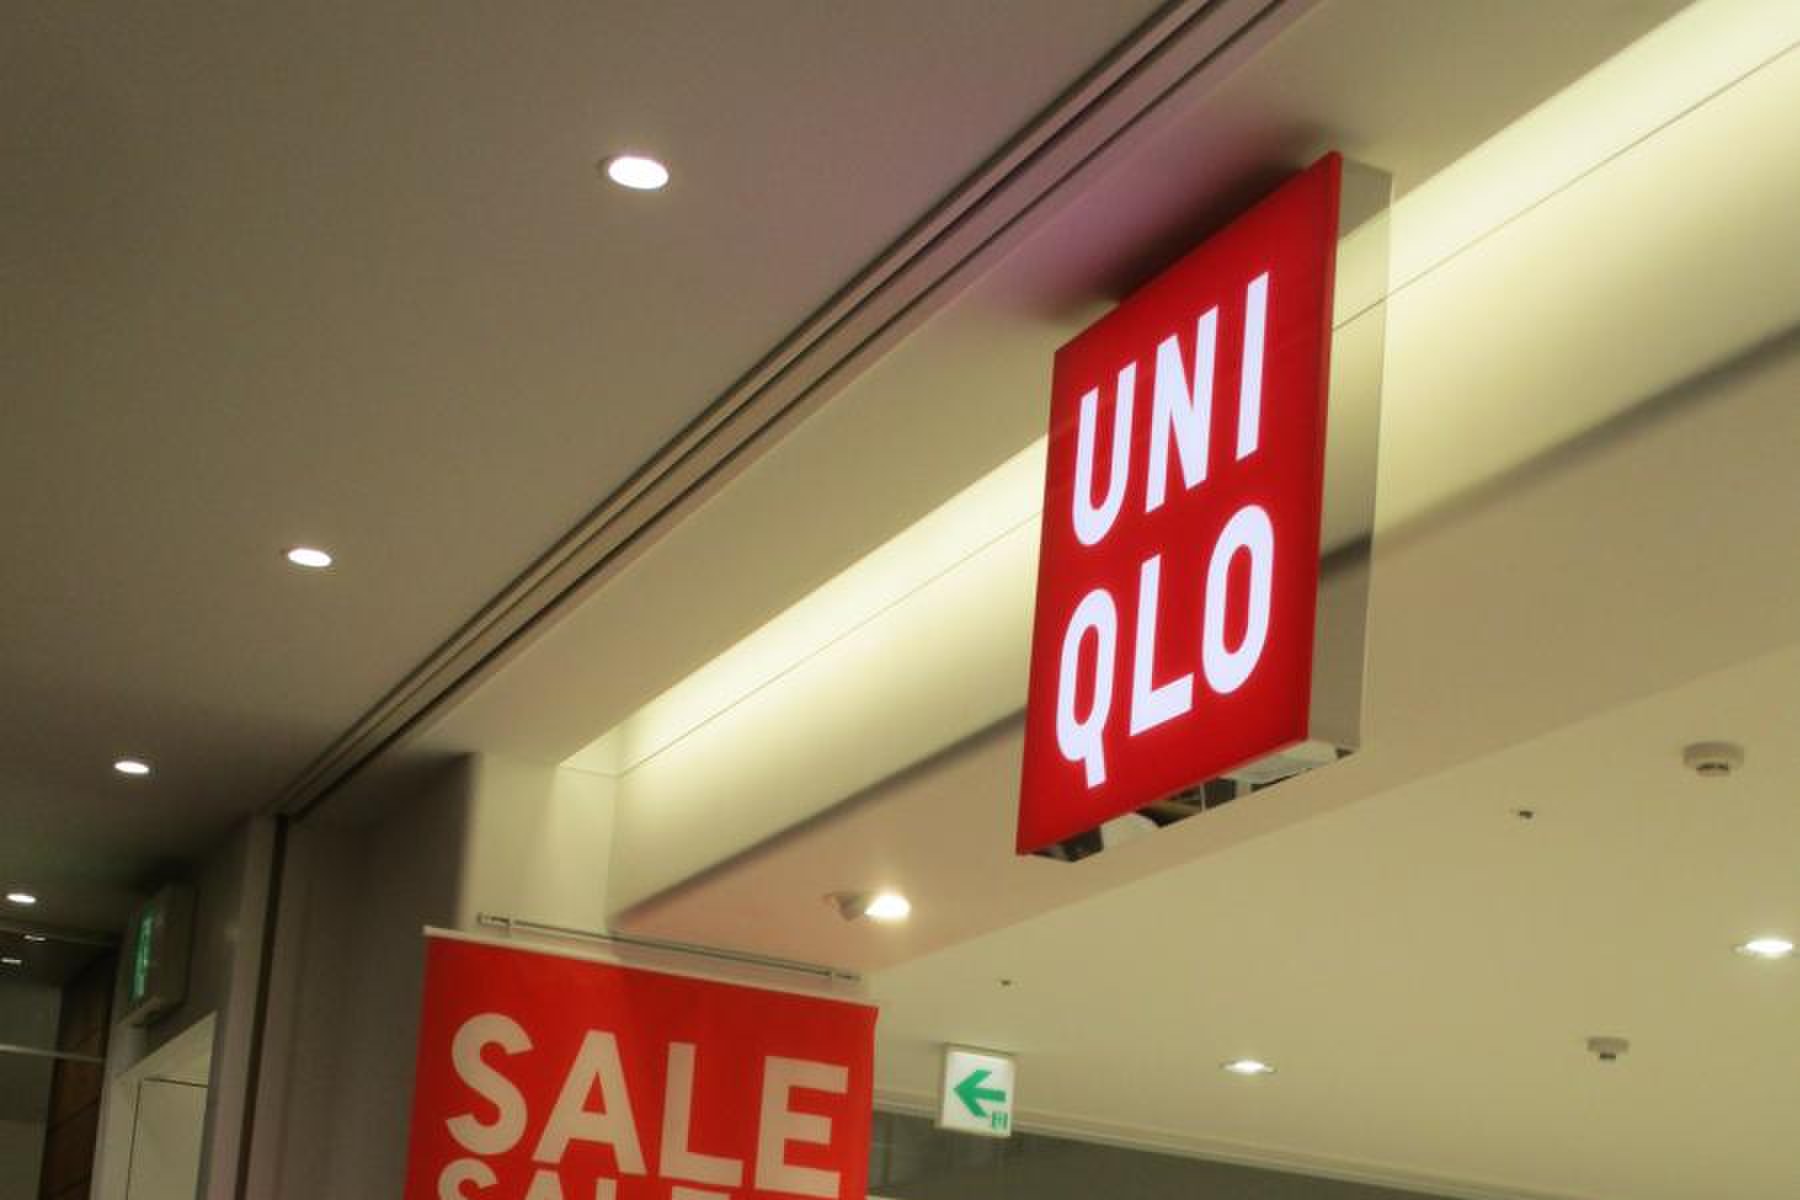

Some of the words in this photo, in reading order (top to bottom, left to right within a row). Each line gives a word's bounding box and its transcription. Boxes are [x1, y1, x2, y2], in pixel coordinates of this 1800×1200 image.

[1072, 271, 1269, 546] UNI
[1056, 504, 1274, 789] QLO
[446, 1013, 849, 1200] SALE
